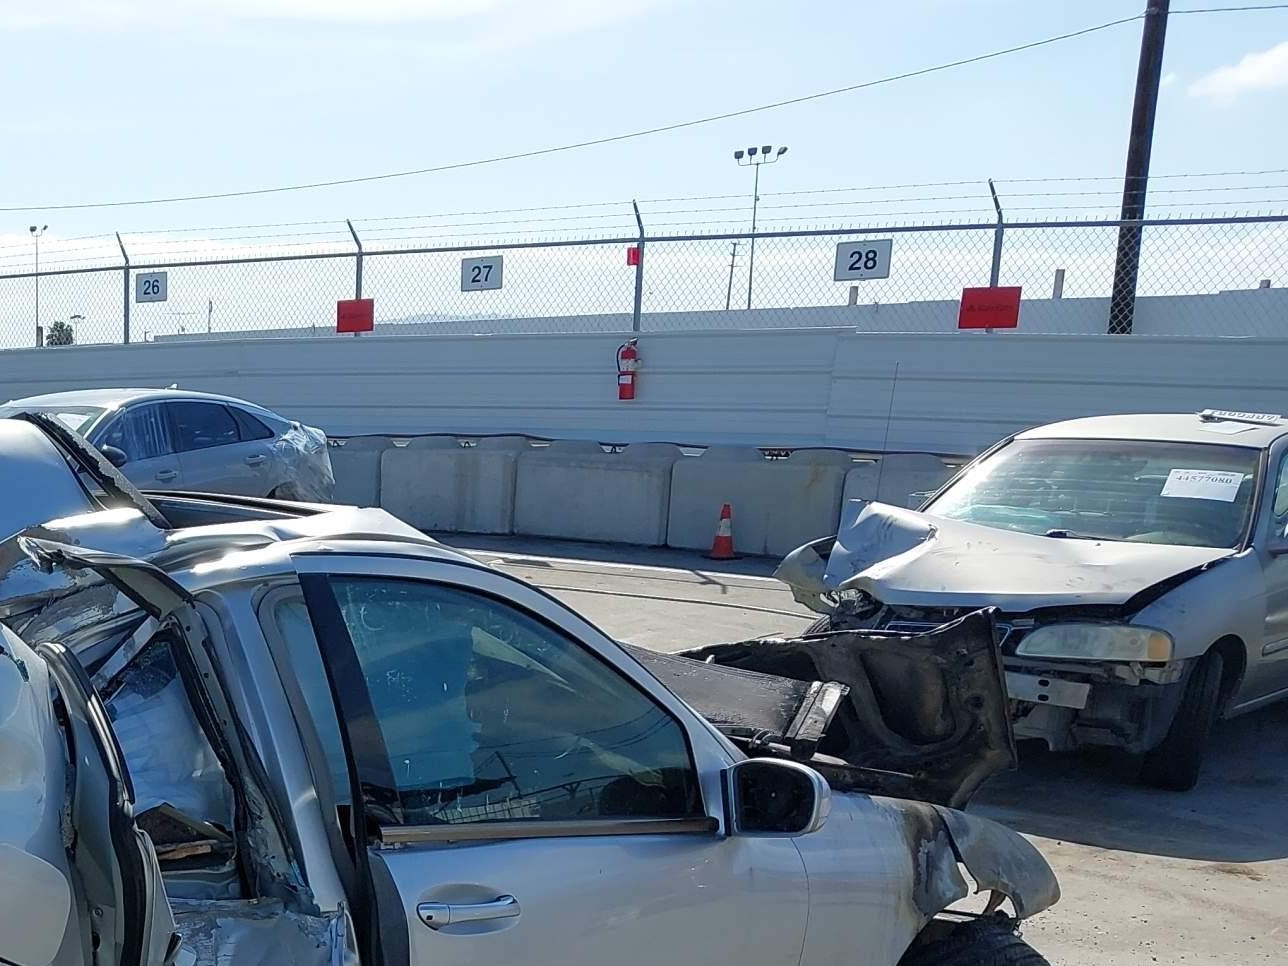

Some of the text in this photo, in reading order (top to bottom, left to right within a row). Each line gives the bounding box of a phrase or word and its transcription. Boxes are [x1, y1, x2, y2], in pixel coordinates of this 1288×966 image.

[848, 249, 878, 271] 28
[471, 265, 493, 283] 27
[143, 279, 160, 295] 26
